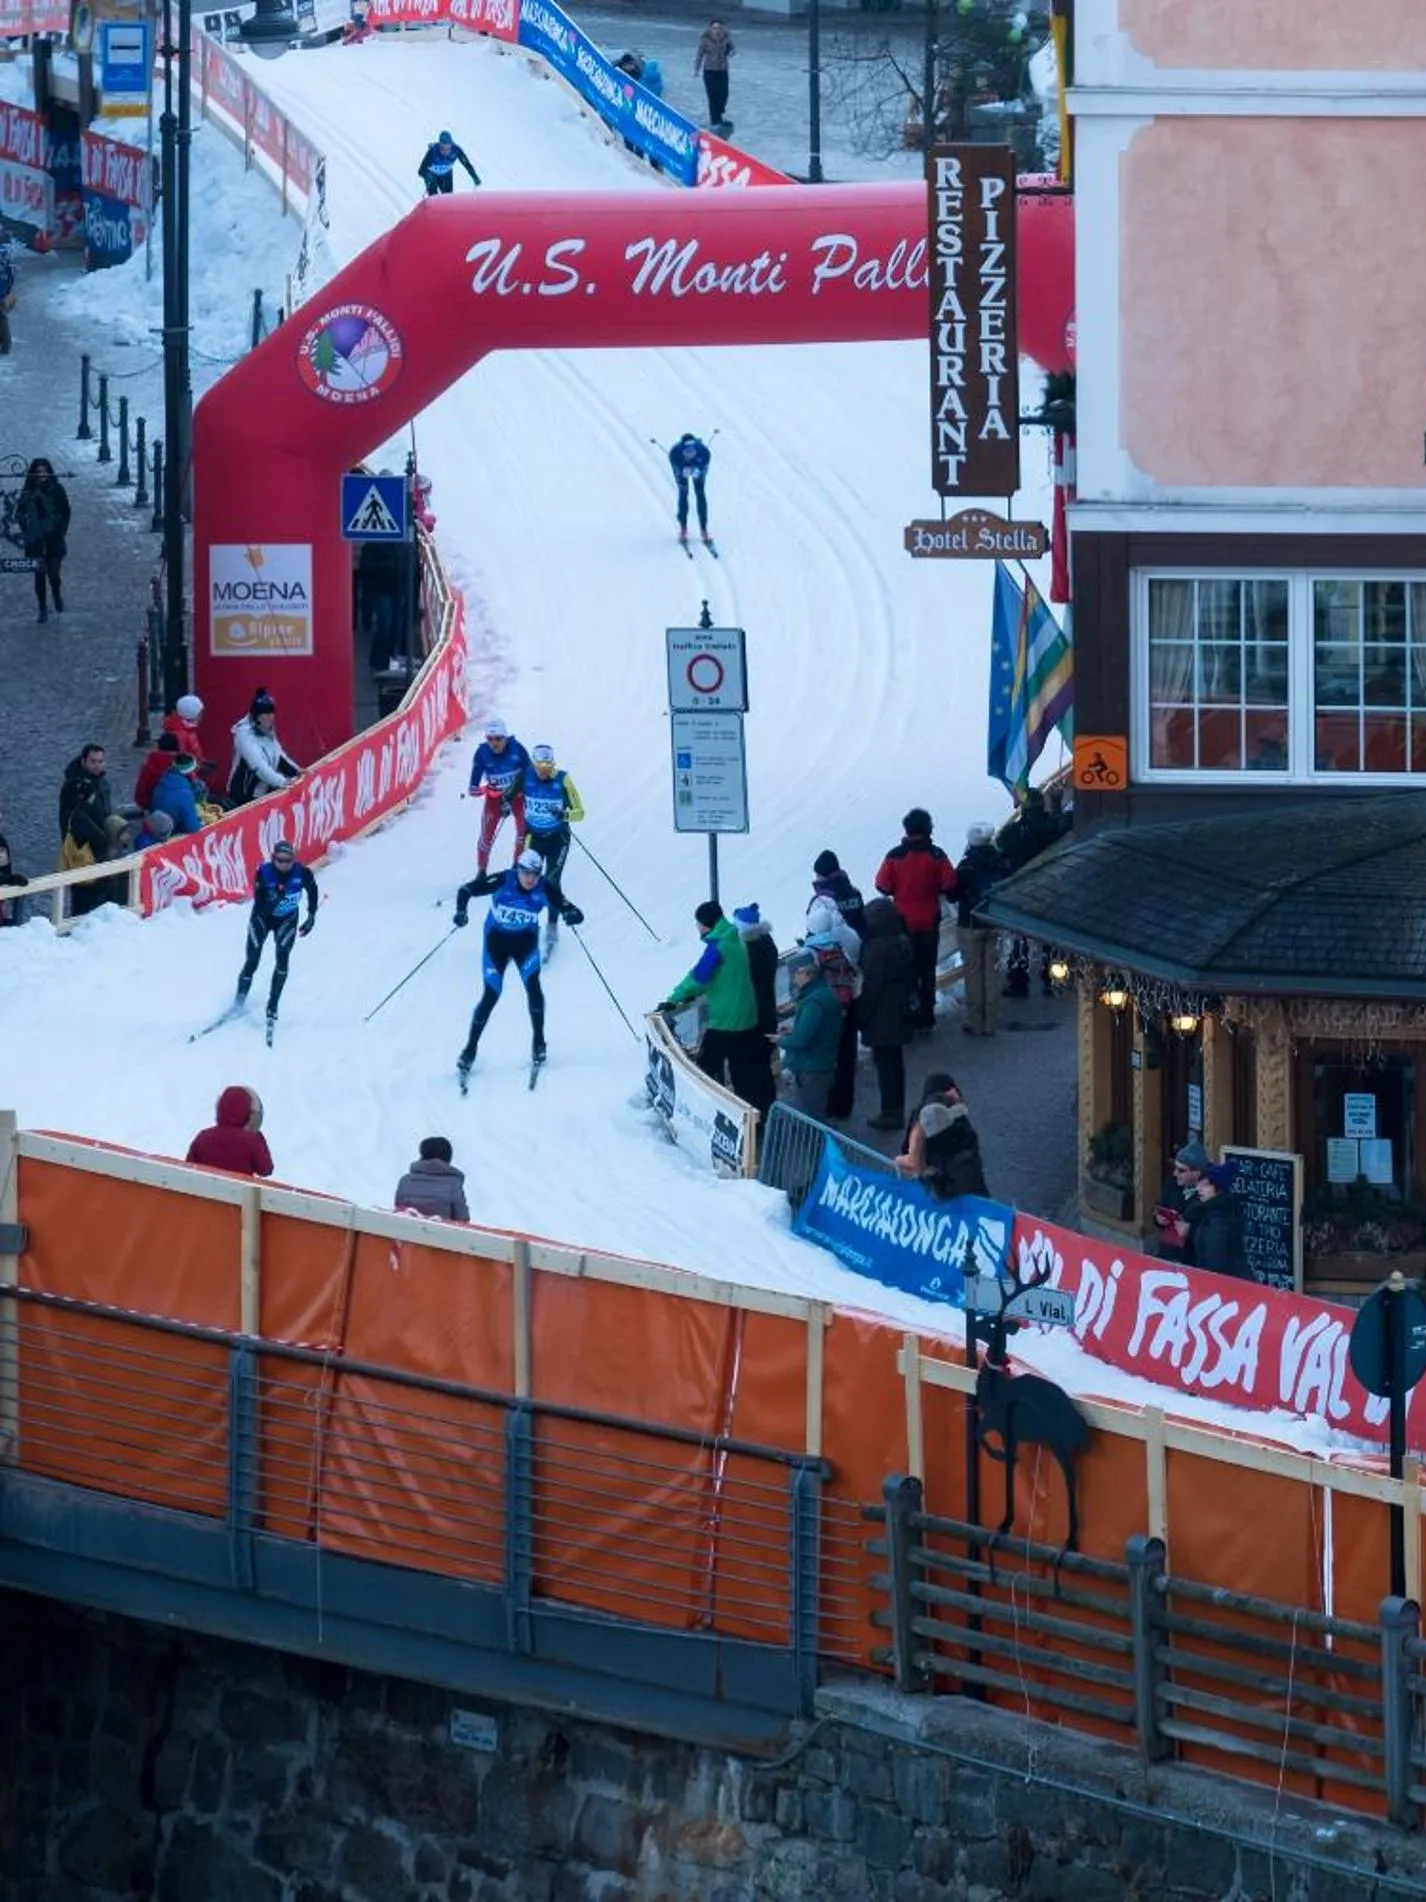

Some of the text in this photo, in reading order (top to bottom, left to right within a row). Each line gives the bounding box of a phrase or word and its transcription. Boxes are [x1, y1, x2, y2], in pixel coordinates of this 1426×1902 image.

[465, 233, 929, 298] U.S. Monti Pall
[935, 157, 968, 486] RESTAURANT
[978, 177, 1011, 440] PIZZERIA
[912, 527, 1038, 554] Hotel Stella
[212, 581, 307, 601] MOENA
[819, 1172, 968, 1269] MARCIALONGA
[1040, 1300, 1066, 1321] Vial
[1074, 1257, 1124, 1341] DI
[1128, 1269, 1267, 1394] FASSA
[1280, 1311, 1349, 1420] VAL
